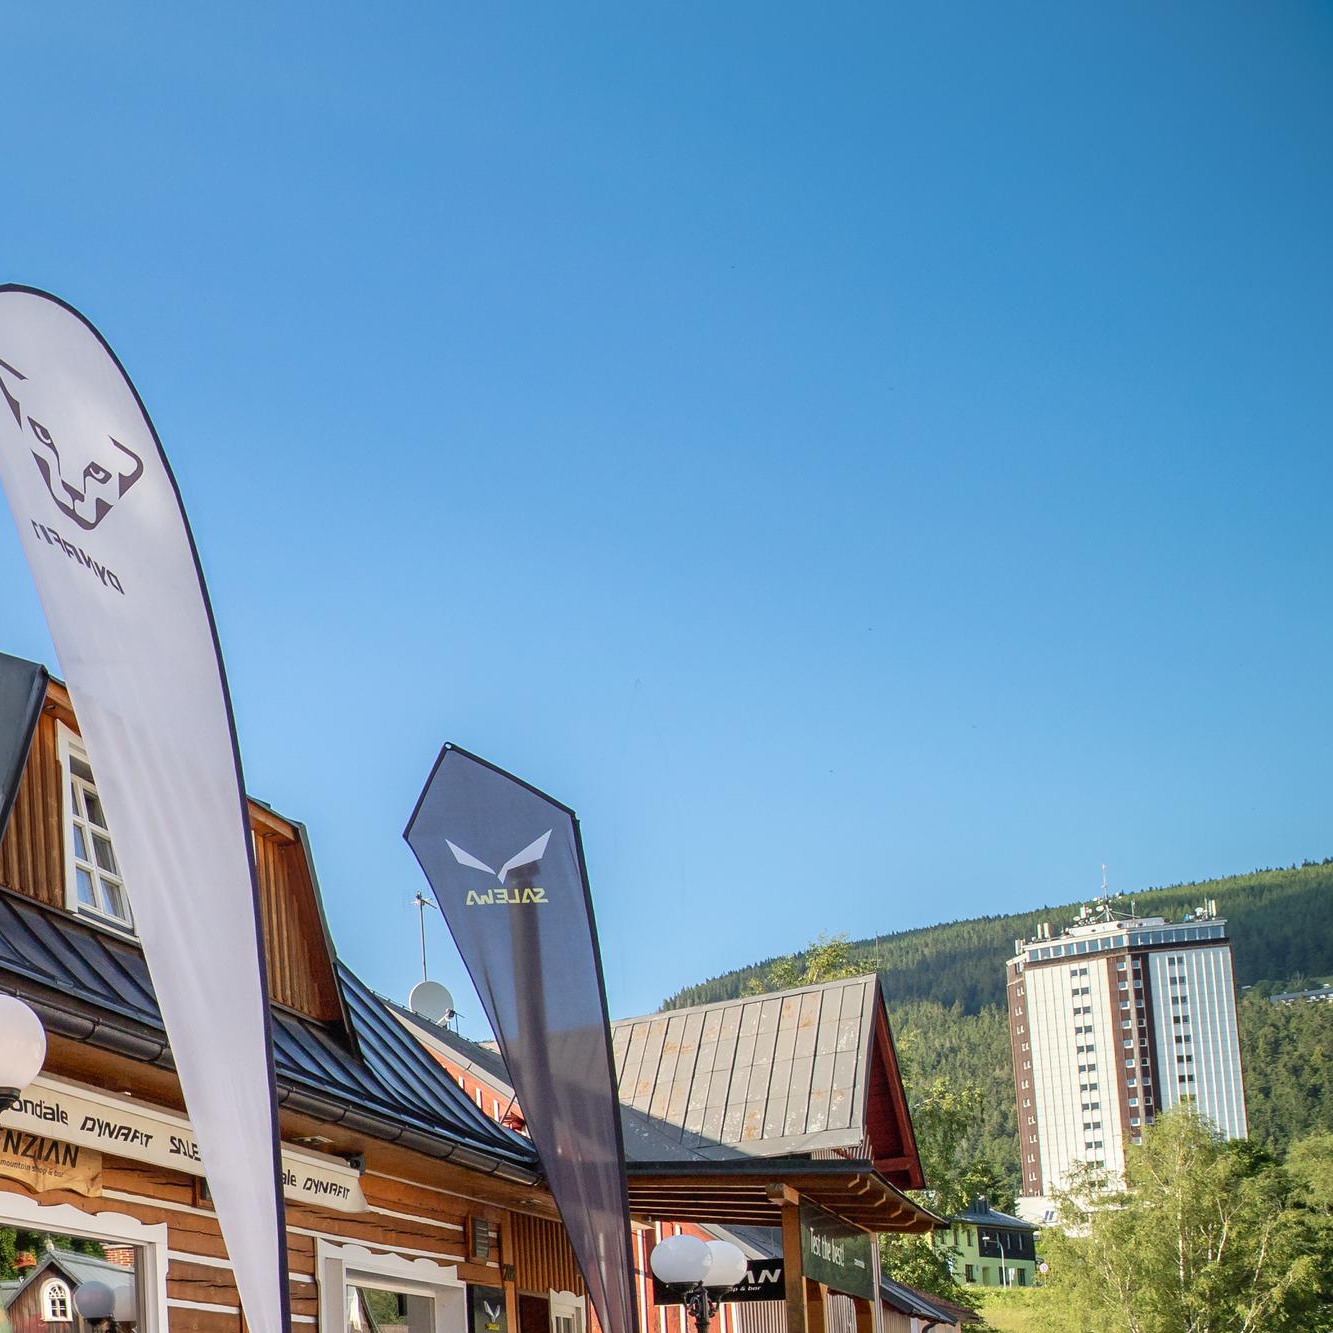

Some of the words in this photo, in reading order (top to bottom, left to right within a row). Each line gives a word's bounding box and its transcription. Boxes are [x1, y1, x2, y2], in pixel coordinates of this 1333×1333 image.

[10, 1098, 69, 1125] ondale
[80, 1116, 153, 1148] DYNAFIT
[169, 1135, 202, 1162] SALE
[302, 1177, 351, 1200] DYNAFIT
